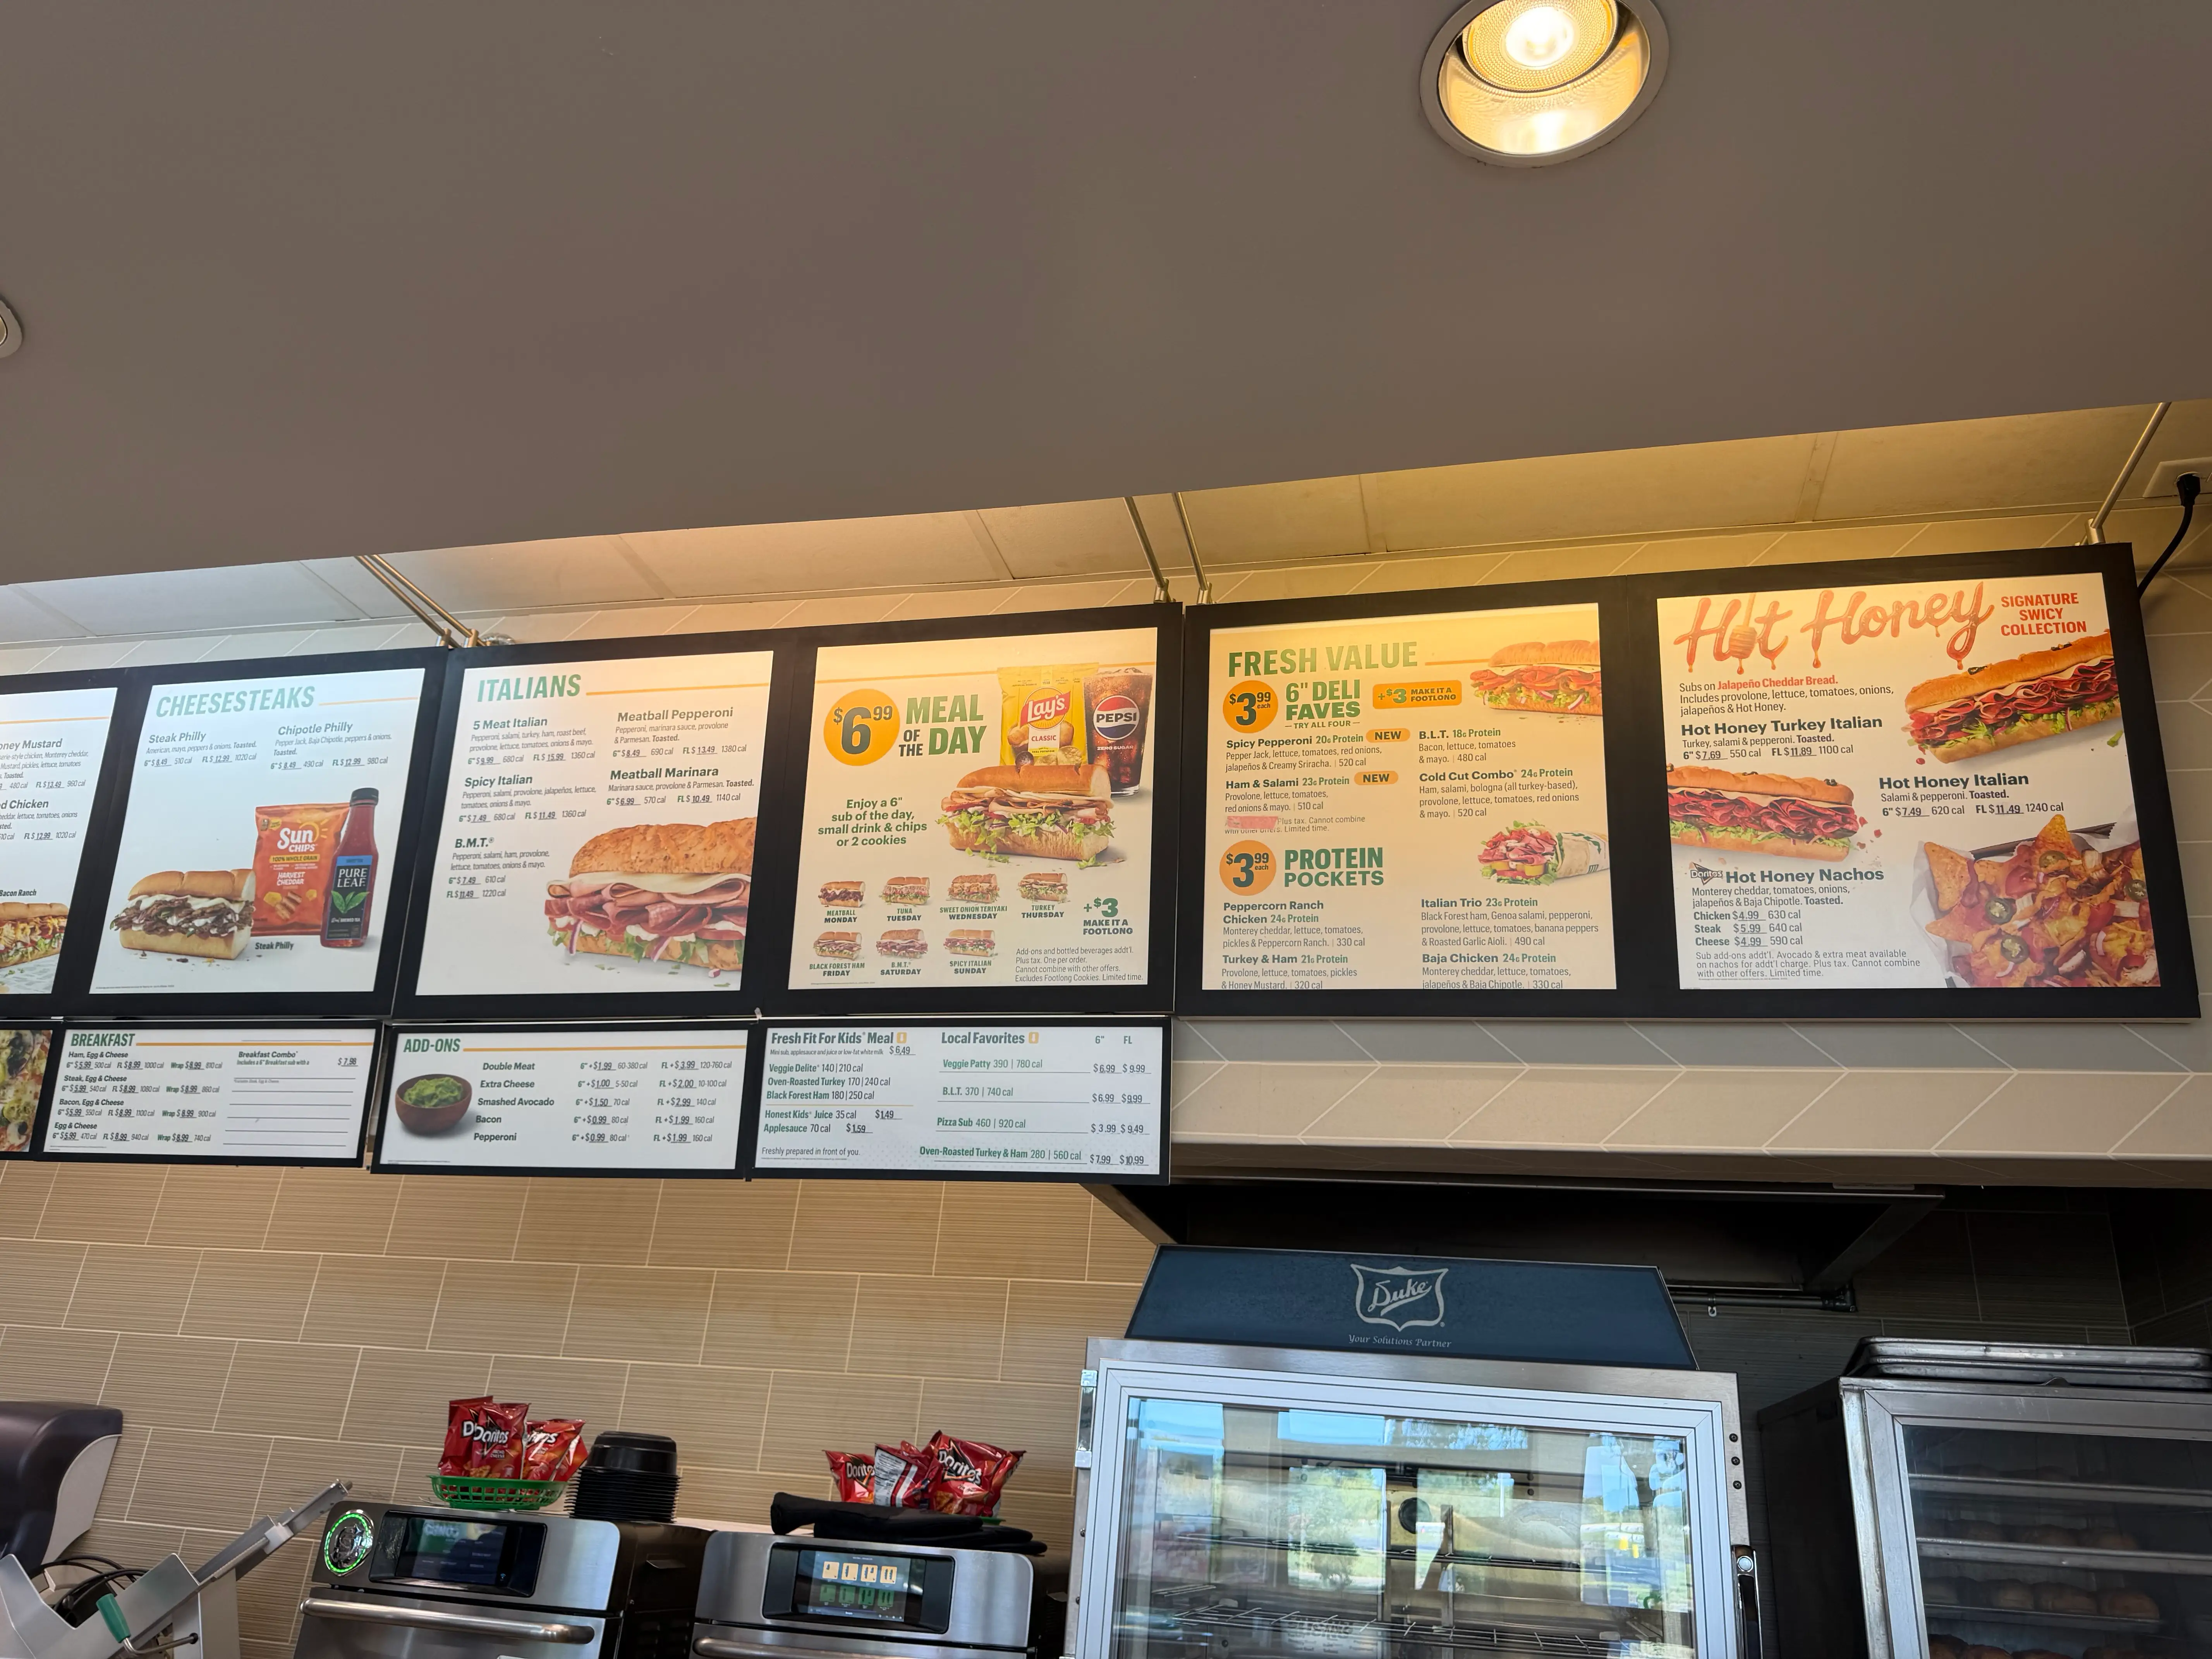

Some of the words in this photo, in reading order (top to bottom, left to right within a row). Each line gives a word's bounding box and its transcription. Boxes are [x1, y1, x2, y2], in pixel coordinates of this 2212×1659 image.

[2001, 592, 2079, 608] SIGNATURE
[2019, 607, 2063, 621] SWICY
[1802, 582, 1995, 670] Honey
[2001, 621, 2087, 636] COLLECTION
[1228, 647, 1317, 678] FRESH
[1326, 641, 1417, 671] VALUE
[477, 674, 581, 702] ITALIANS
[1312, 679, 1360, 701] DELI
[1679, 682, 1702, 692] Subs
[1717, 679, 1760, 691] Jalapeño
[1762, 677, 1804, 688] Cheddar
[1805, 675, 1838, 685] Bread.
[156, 685, 316, 718] CHEESESTEAKS
[617, 709, 669, 722] Meatball
[671, 706, 733, 721] Pepperoni
[905, 694, 984, 725] MEAL
[1027, 695, 1065, 722] Lay's
[1286, 701, 1361, 721] FAVES
[473, 720, 481, 730] 5
[483, 720, 511, 730] Meat
[513, 716, 548, 728] Italian
[1096, 712, 1137, 723] PEPSI
[278, 723, 322, 737] Chipotle
[324, 721, 353, 733] Philly
[1681, 724, 1711, 736] Hot
[1714, 723, 1767, 735] Honey
[1771, 718, 1826, 733] Turkey
[1830, 716, 1882, 729] Italian
[148, 732, 177, 744] Steak
[178, 731, 206, 742] Philly
[903, 729, 921, 742] OF
[928, 725, 987, 756] DAY
[1375, 731, 1401, 740] NEW
[1419, 730, 1449, 740] B.L.T.
[22, 738, 63, 749] Mustard
[1226, 739, 1255, 750] Spicy
[1258, 735, 1312, 748] Pepperoni
[1447, 742, 1476, 750] lettuce,
[1478, 741, 1516, 749] tomatoes
[898, 743, 924, 757] THE
[610, 768, 662, 780] Meatball
[665, 766, 719, 778] Marinara
[1363, 773, 1390, 783] NEW
[464, 776, 496, 789] Spicy
[498, 774, 533, 785] Italian
[1226, 781, 1250, 789] Ham
[1252, 780, 1261, 788] &
[1262, 778, 1298, 788] Salami
[1879, 777, 1910, 789] Hot
[1914, 776, 1970, 789] Honey
[1974, 773, 2029, 786] Italian
[9, 799, 49, 809] Chicken
[846, 798, 878, 810] Enjoy
[831, 811, 853, 822] sub
[855, 809, 867, 821] of
[869, 810, 889, 820] the
[891, 809, 915, 821] day,
[818, 824, 849, 835] small
[851, 822, 881, 834] drink
[884, 823, 893, 832] &
[895, 821, 927, 833] chips
[278, 828, 313, 850] Sun
[836, 839, 849, 847] or
[851, 836, 859, 846] 2
[861, 835, 907, 846] cookies
[289, 844, 315, 852] CHIPS
[1285, 847, 1383, 870] PROTEIN
[339, 869, 367, 878] PURE
[1284, 870, 1384, 888] POCKETS
[1690, 870, 1723, 878] Doritos
[1726, 871, 1757, 883] Hot
[1760, 870, 1815, 883] Honey
[1819, 867, 1884, 881] Nachos
[1223, 902, 1287, 913] Peppercorn
[1289, 900, 1324, 910] Ranch
[1421, 898, 1457, 908] Italian
[1460, 897, 1482, 907] Trio
[1693, 911, 1731, 921] Chicken
[1083, 927, 1133, 935] FOOTLONG
[1694, 924, 1721, 933] Steak
[1695, 937, 1730, 946] Cheese
[1057, 957, 1068, 965] per
[1422, 953, 1447, 965] Baja
[1449, 953, 1498, 963] Chicken
[70, 1033, 136, 1047] BREAKFAST
[941, 1031, 971, 1044] Local
[972, 1031, 1025, 1044] Favorites
[403, 1038, 461, 1053] ADD-ONS
[86, 1051, 99, 1060] Egg
[483, 1062, 512, 1070] Double
[943, 1059, 969, 1070] Veggie
[970, 1059, 991, 1070] Patty
[993, 1059, 1008, 1068] 390
[503, 1079, 535, 1088] Cheese
[477, 1097, 517, 1106] Smashed
[517, 1097, 555, 1106] Avocado
[475, 1115, 501, 1123] Bacon
[474, 1132, 517, 1142] Pepperoni
[762, 1147, 785, 1157] Freshly
[785, 1147, 814, 1156] prepared
[823, 1147, 838, 1156] front
[839, 1147, 846, 1156] of
[1367, 1279, 1432, 1316] Duke
[1349, 1334, 1370, 1343] Your
[1372, 1336, 1412, 1345] Solutions
[1415, 1339, 1451, 1348] Partner
[473, 1425, 509, 1444] Doritos
[938, 1450, 982, 1484] Doritos
